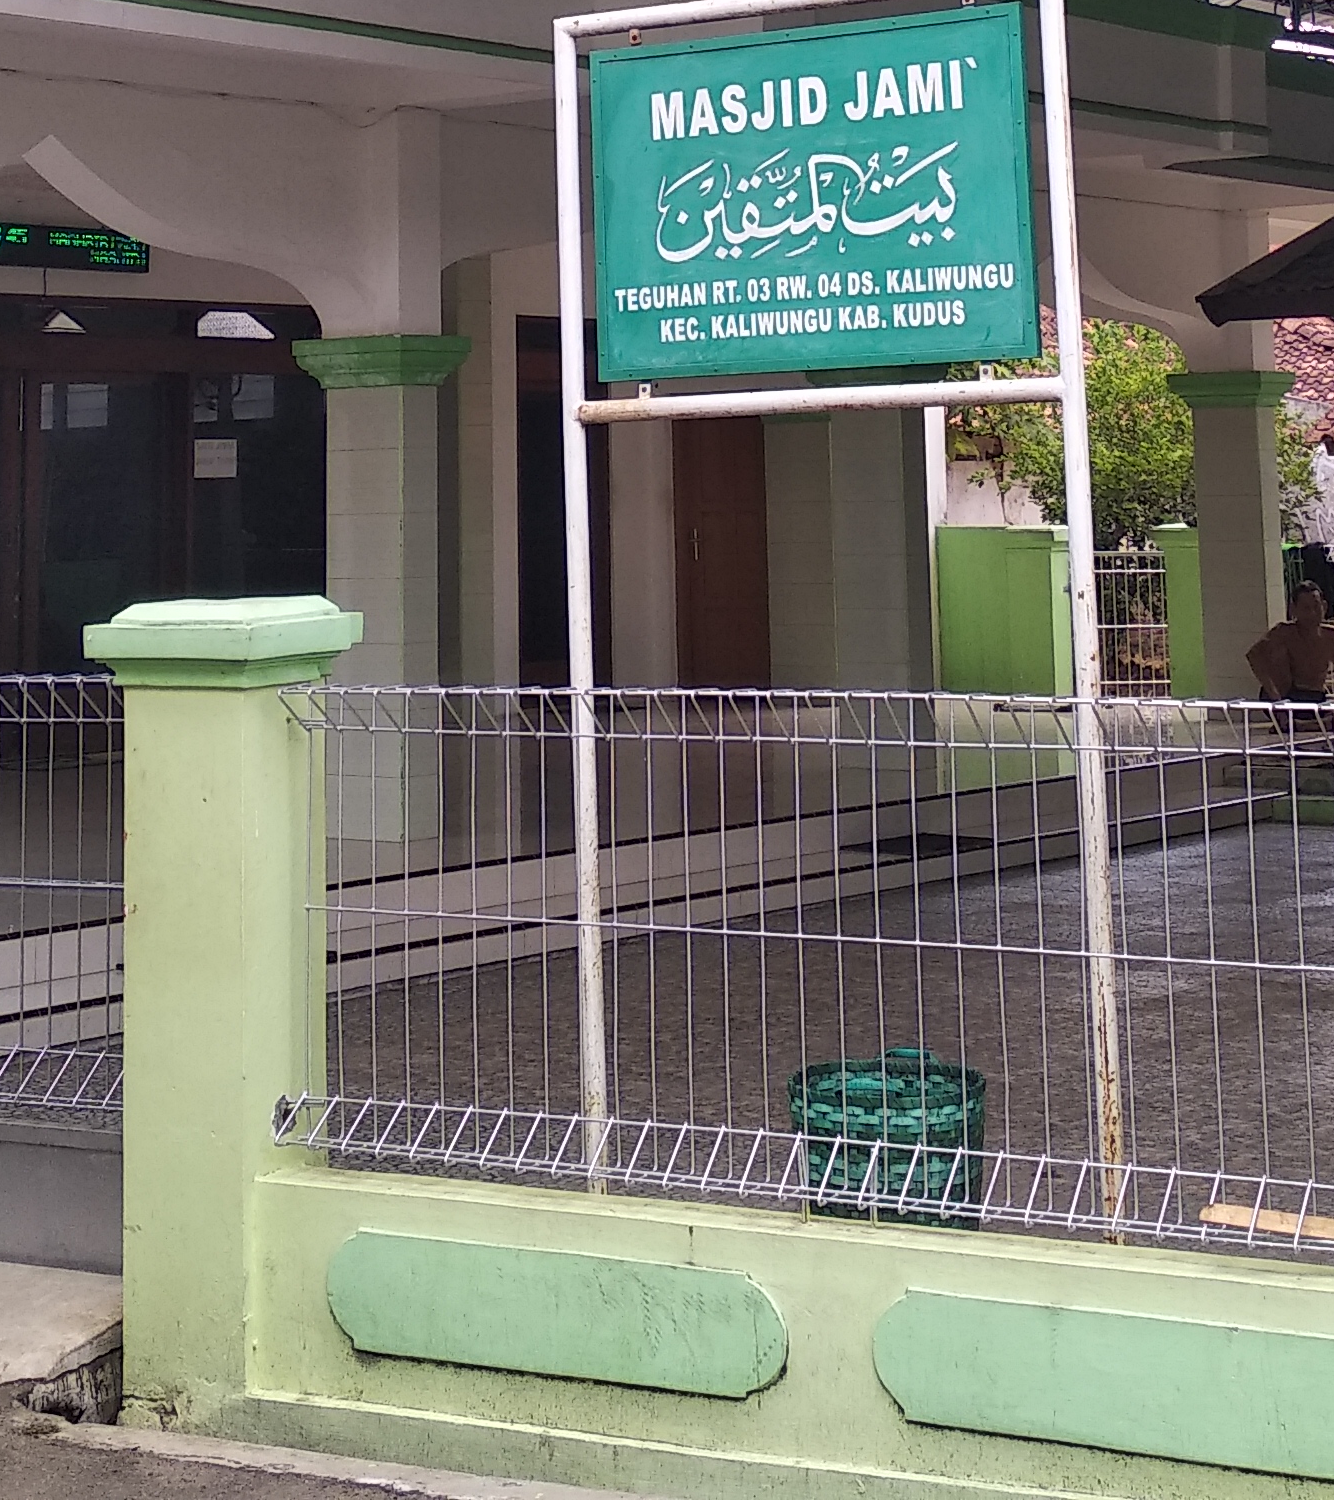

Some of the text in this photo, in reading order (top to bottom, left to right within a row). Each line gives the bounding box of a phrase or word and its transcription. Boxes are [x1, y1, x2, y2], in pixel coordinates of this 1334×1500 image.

[651, 75, 827, 141] MASJID
[614, 262, 1015, 313] TEGUHAN RT. 03 RW. 04 DS. KALIWUNGU
[660, 299, 965, 343] KEC. KALIWUNGU KAB. KUDUS
